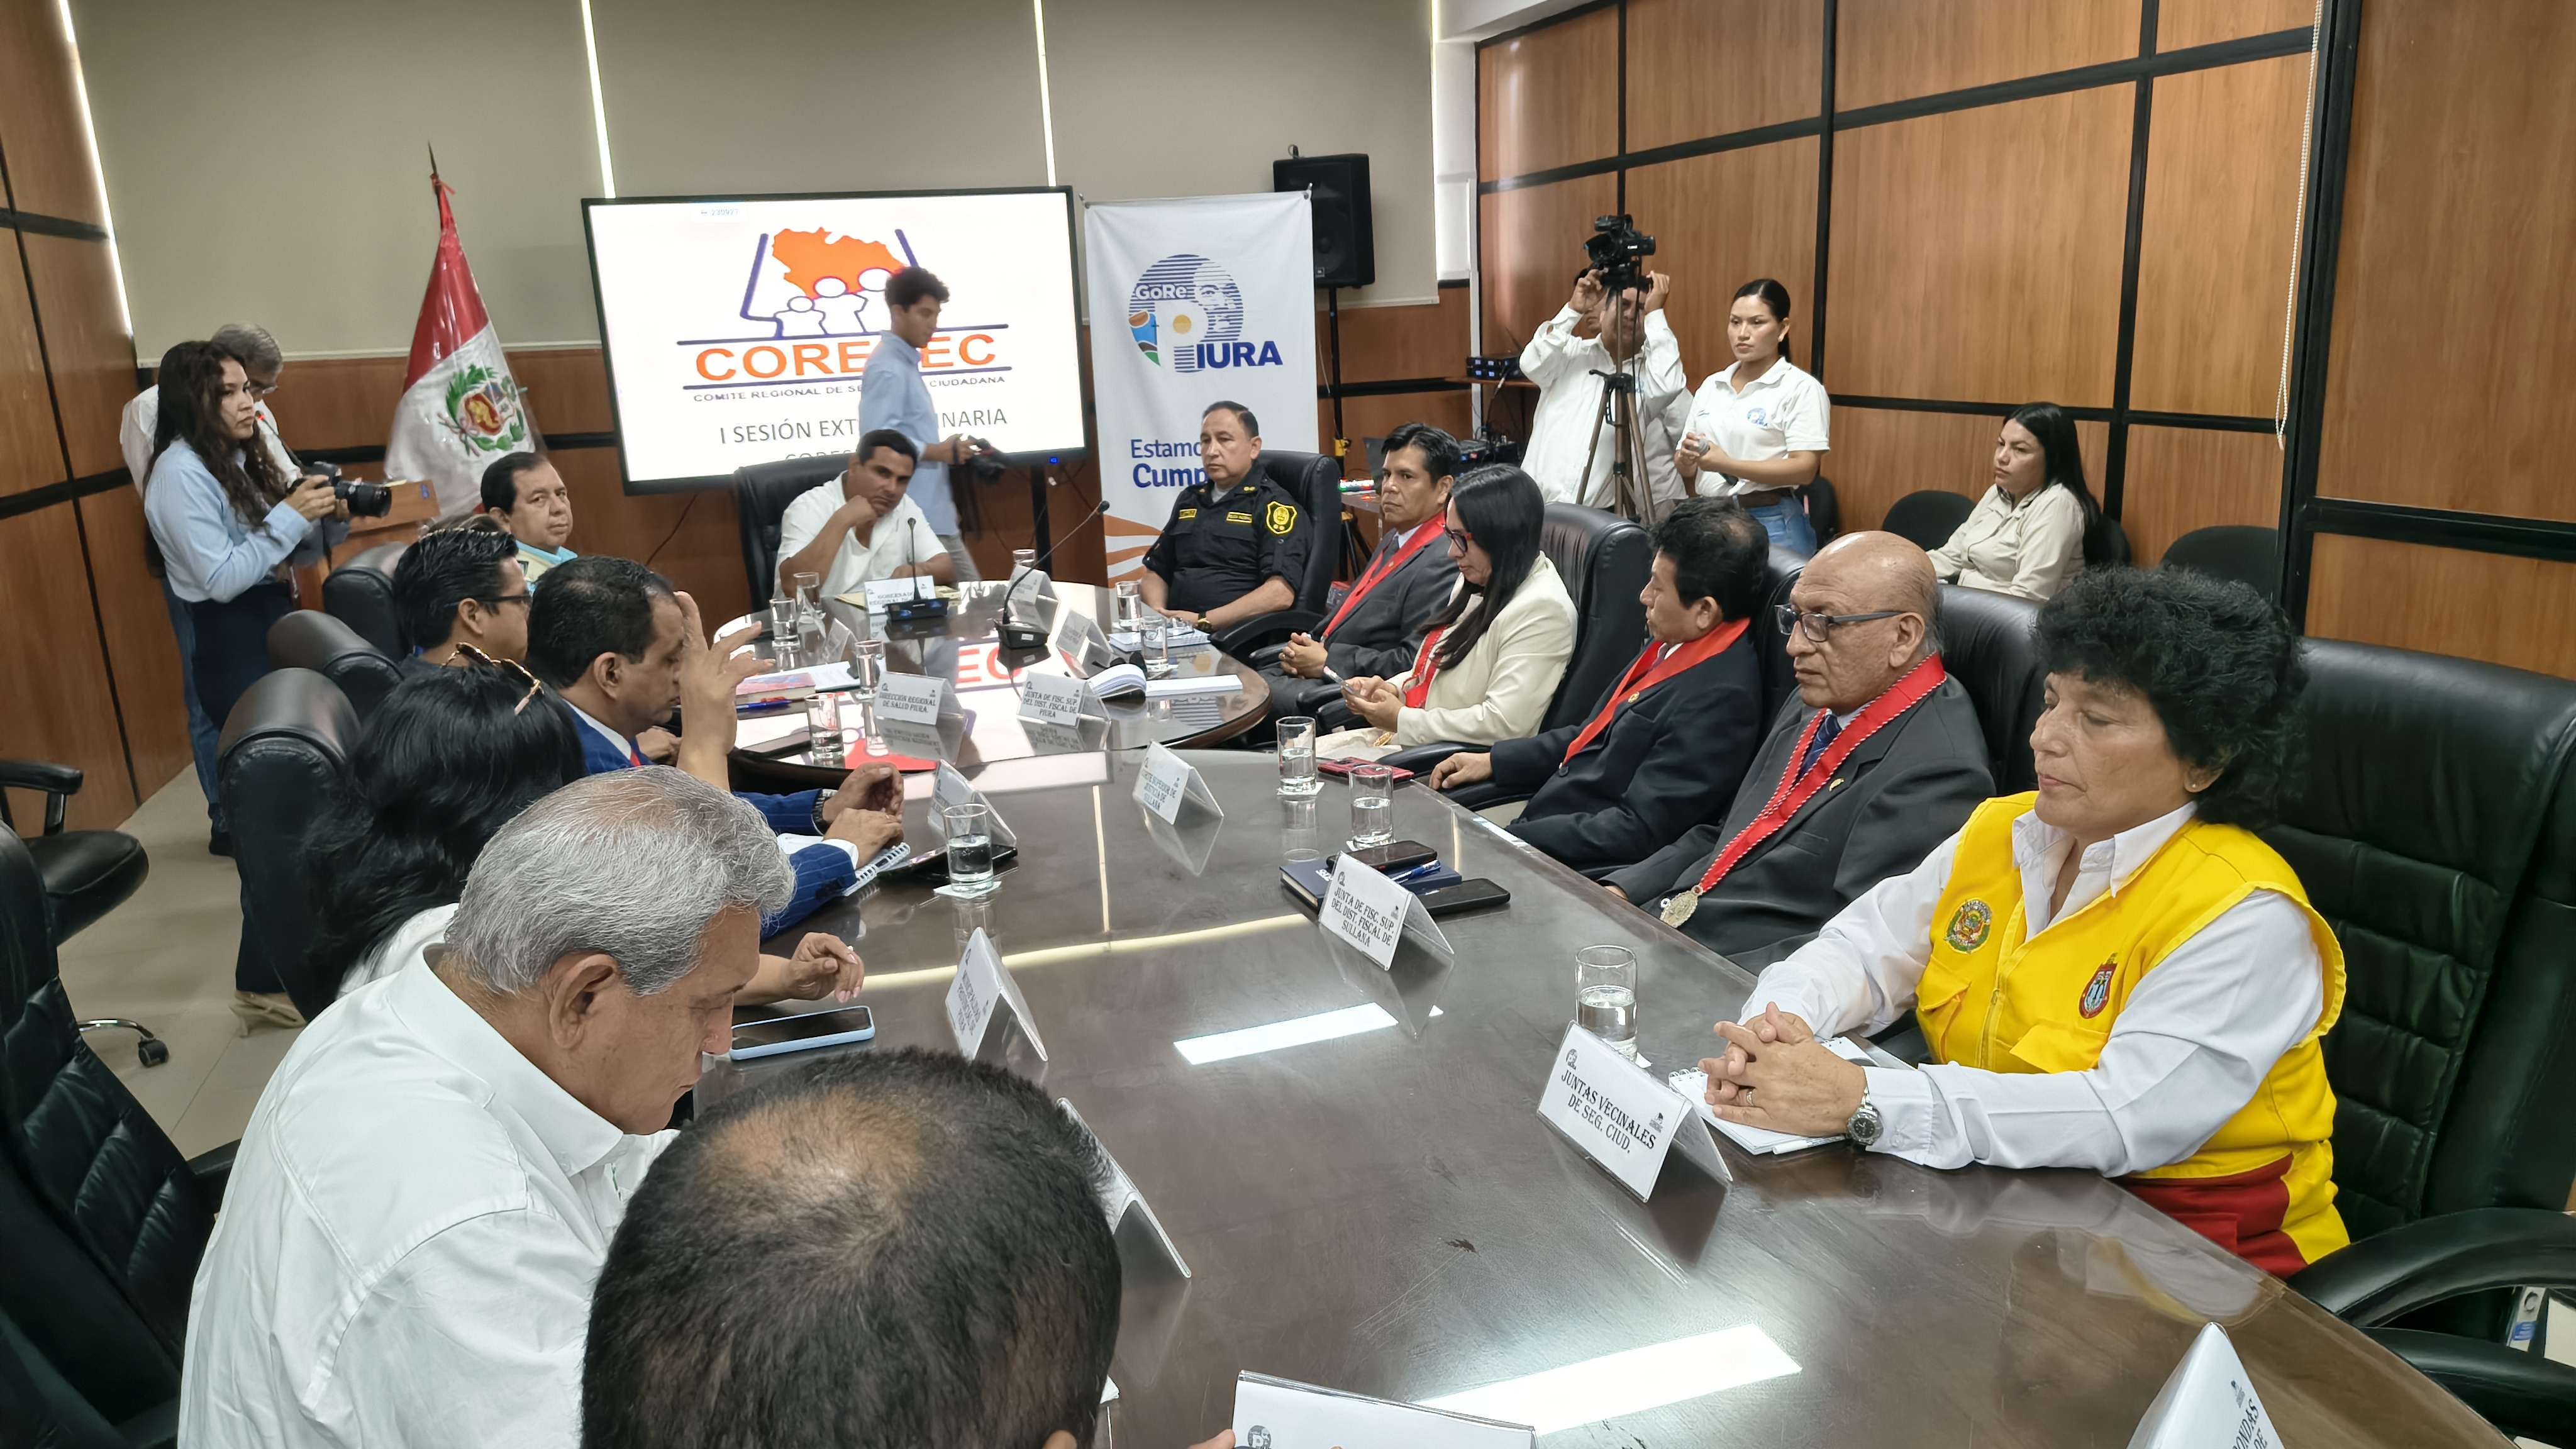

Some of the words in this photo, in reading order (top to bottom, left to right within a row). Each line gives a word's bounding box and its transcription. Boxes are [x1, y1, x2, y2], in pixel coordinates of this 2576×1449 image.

[1135, 283, 1187, 299] GoRe
[696, 333, 996, 381] COREEC
[694, 392, 747, 402] COMITE
[751, 388, 821, 398] REGIONAL
[826, 386, 843, 394] DE
[929, 376, 1006, 387] CIUDADANA
[720, 427, 726, 444] I
[733, 418, 811, 443] SESIÓN
[1131, 438, 1202, 458] Estamo
[1025, 691, 1042, 699] JUNTA
[1069, 706, 1077, 714] DE
[1331, 897, 1343, 913] DEL
[1343, 906, 1357, 924] DIST.
[1358, 916, 1380, 940] FISCAL
[1382, 931, 1392, 947] DE
[1335, 887, 1353, 907] JUNTA
[1354, 899, 1364, 913] DE
[1363, 905, 1379, 923] FISC.
[1380, 916, 1394, 934] SUP.
[1341, 919, 1370, 947] SULLANA
[1561, 1069, 1598, 1106] JUNTAS
[1599, 1095, 1657, 1150] VECINALES
[1568, 1094, 1581, 1114] DE
[1582, 1105, 1603, 1132] SEG.
[1606, 1124, 1631, 1154] CIUD.
[2232, 1397, 2259, 1449] ONDAS
